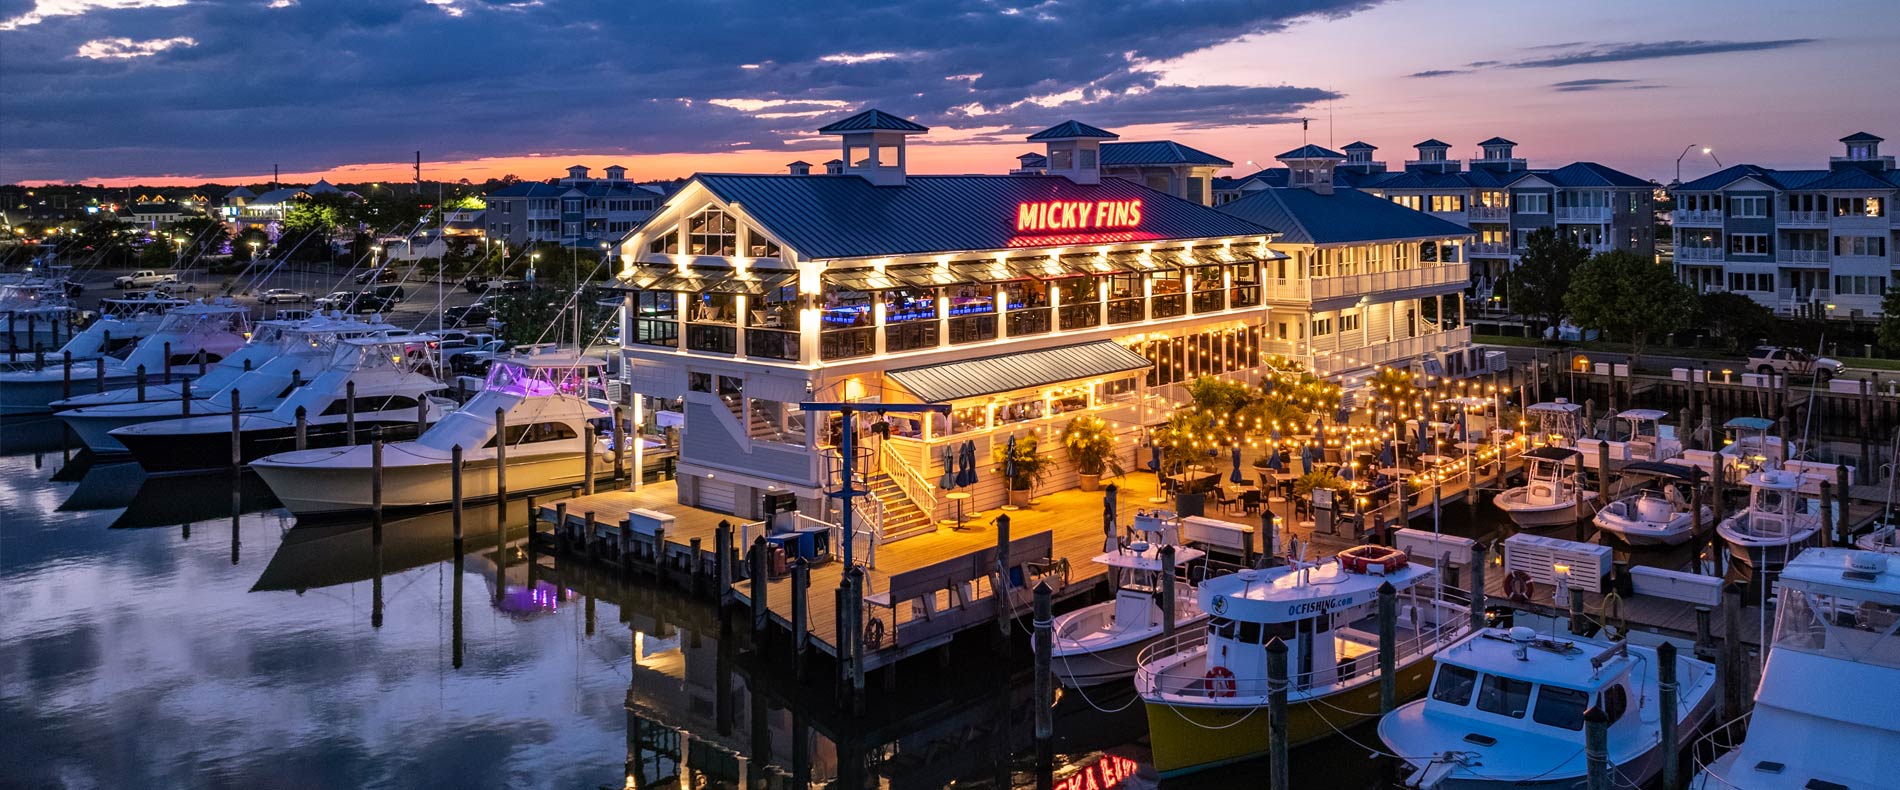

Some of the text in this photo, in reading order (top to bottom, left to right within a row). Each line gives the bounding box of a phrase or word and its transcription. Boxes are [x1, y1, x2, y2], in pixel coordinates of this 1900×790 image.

[1018, 200, 1142, 231] MICKY FINS
[1288, 596, 1353, 616] OCFISHING.com
